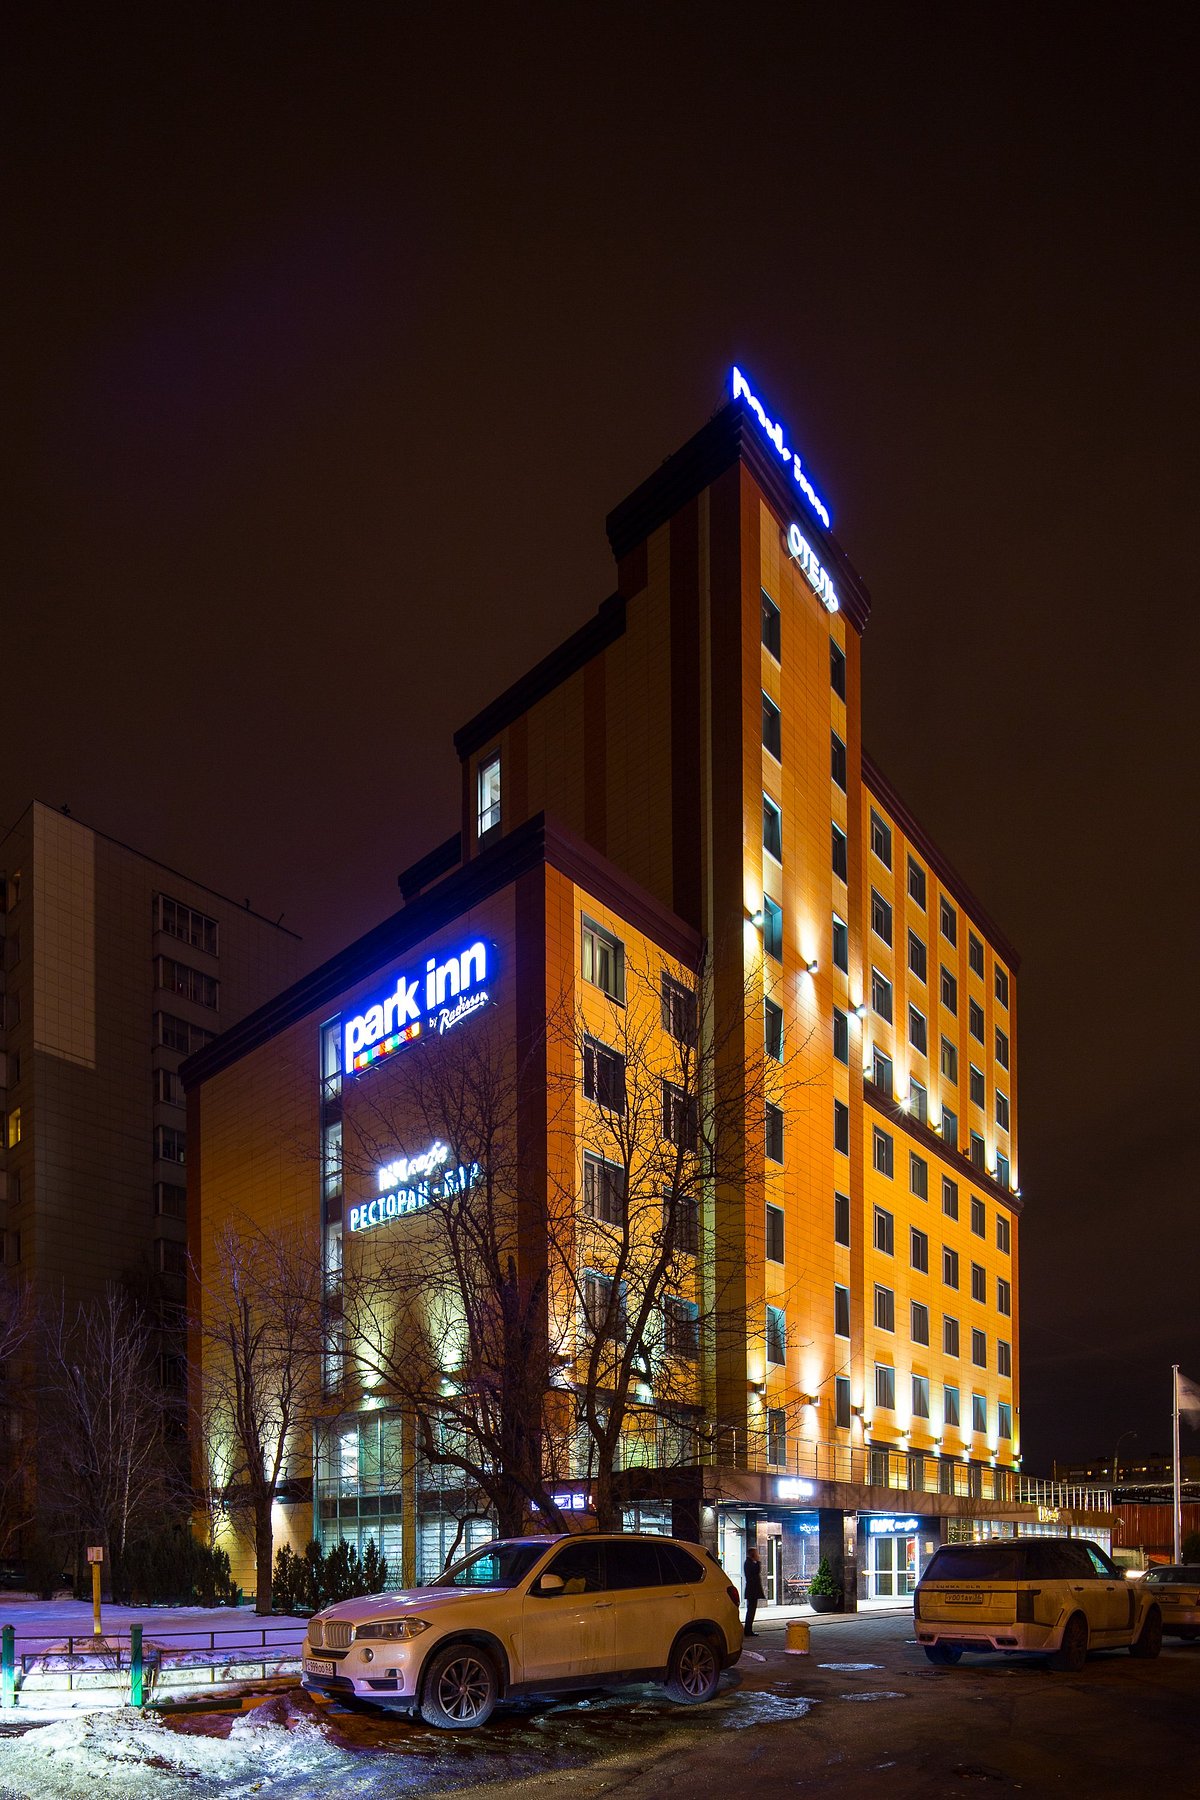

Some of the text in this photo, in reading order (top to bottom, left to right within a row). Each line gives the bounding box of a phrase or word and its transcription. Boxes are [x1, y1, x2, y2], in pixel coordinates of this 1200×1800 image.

[787, 523, 839, 613] ОТЕЛЬ
[345, 941, 486, 1074] park inn
[429, 991, 489, 1035] by Radisson
